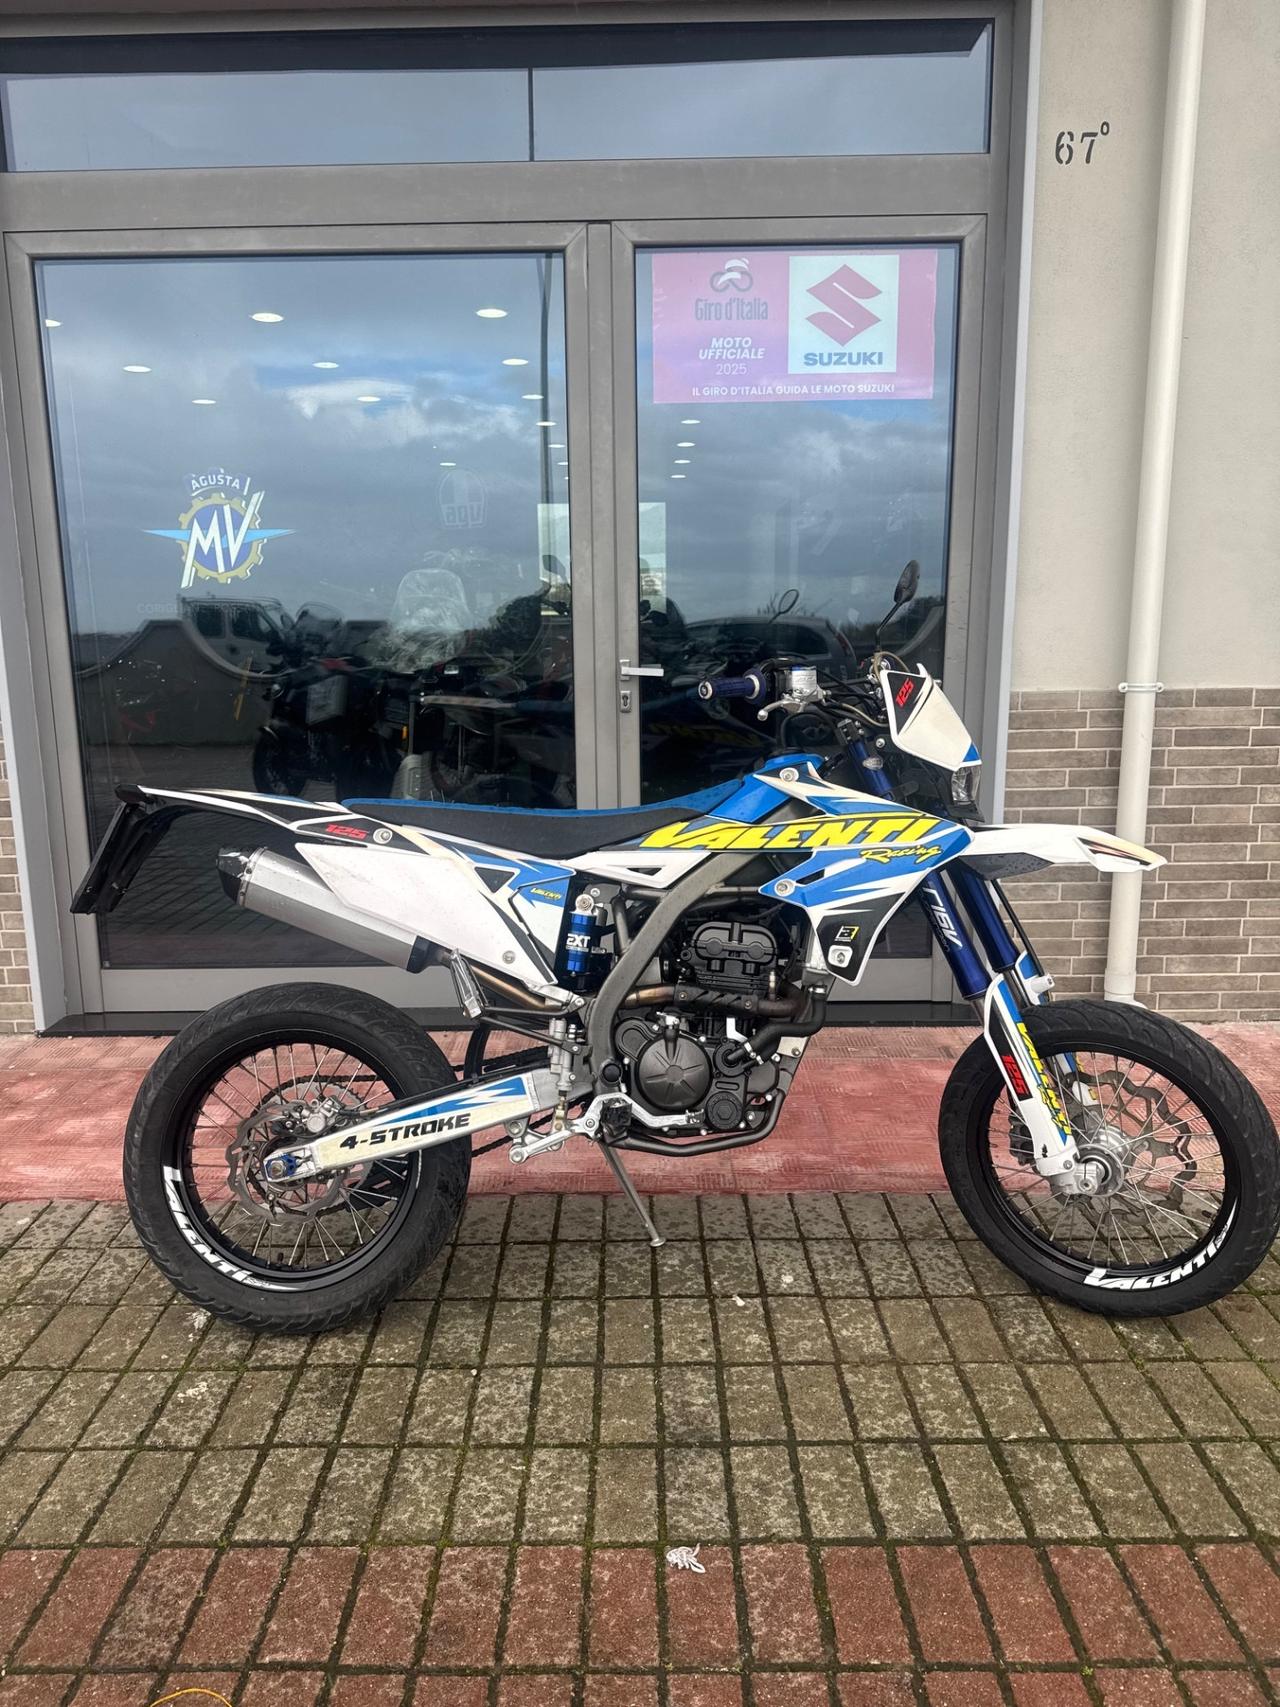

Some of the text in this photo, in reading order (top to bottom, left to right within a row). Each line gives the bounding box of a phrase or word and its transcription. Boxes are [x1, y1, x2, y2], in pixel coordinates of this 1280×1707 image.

[695, 297, 768, 321] Giro d'Italia
[711, 337, 752, 348] MOTO
[698, 348, 765, 360] UFFICIALE
[803, 352, 883, 366] SUZUKI
[715, 364, 747, 376] 2025
[692, 384, 895, 396] IL GIRO D'ITALIA GUIDA LE MOTO SUZUKI
[191, 474, 240, 490] AGUSTA
[181, 490, 262, 589] MV
[325, 823, 368, 840] 125
[638, 817, 942, 849] VALENTI
[860, 845, 942, 864] Racing
[1001, 1055, 1030, 1096] 125
[339, 1113, 471, 1149] 4-STROKE
[163, 1165, 253, 1283] VALENTI
[1083, 1236, 1217, 1290] VALENTI
